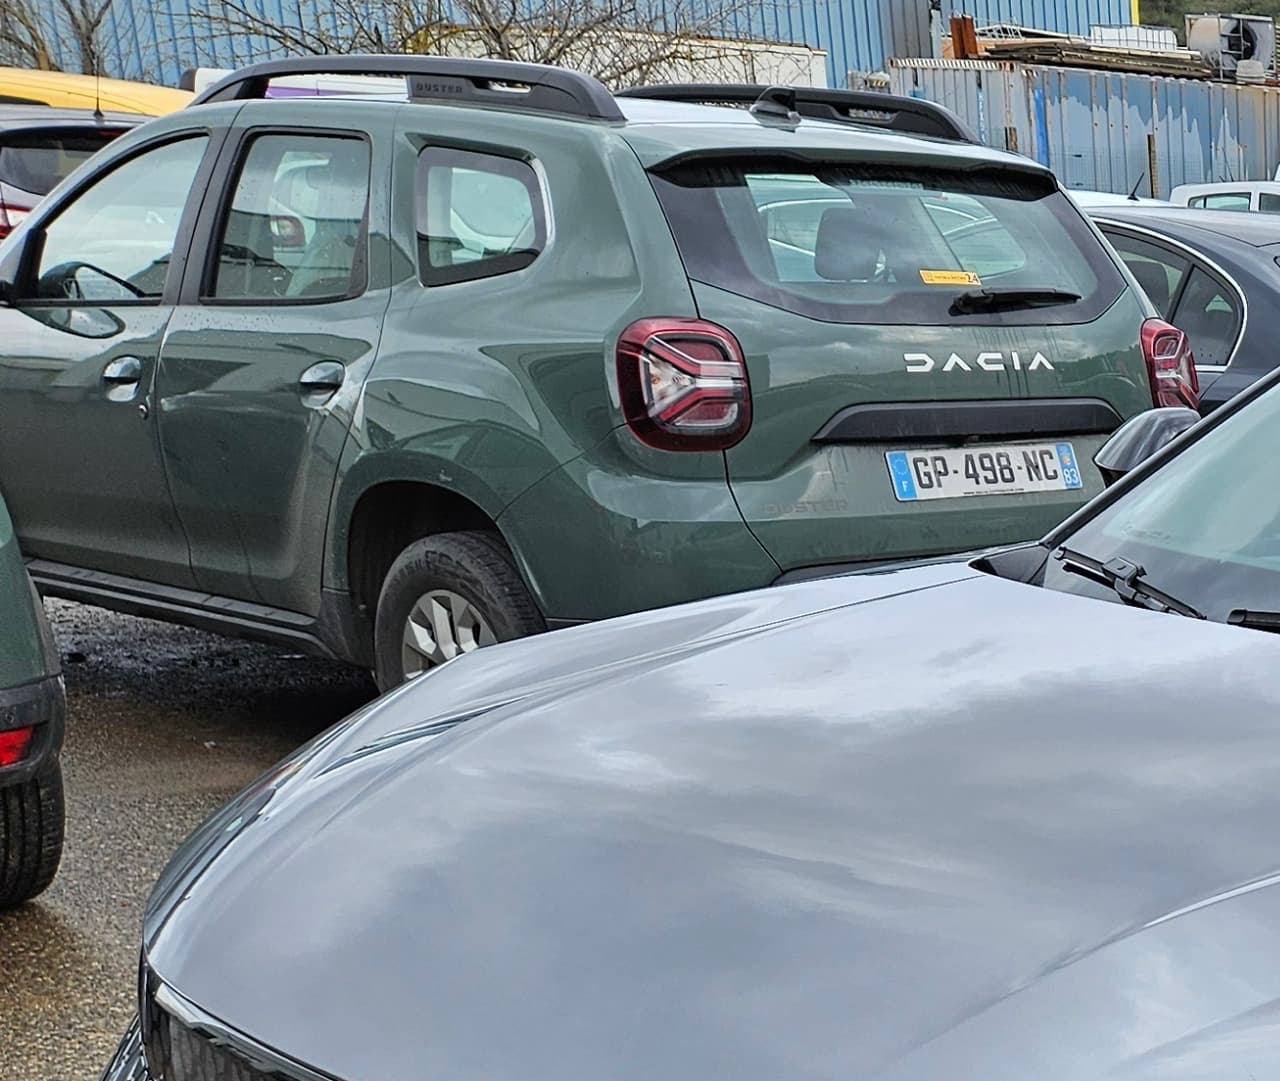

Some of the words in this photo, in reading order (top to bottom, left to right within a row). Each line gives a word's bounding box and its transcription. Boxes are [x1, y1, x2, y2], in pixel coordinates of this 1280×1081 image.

[904, 351, 1055, 374] DACIA
[913, 449, 1059, 490] GP-498-NC
[1063, 468, 1080, 485] 83
[902, 481, 909, 492] F
